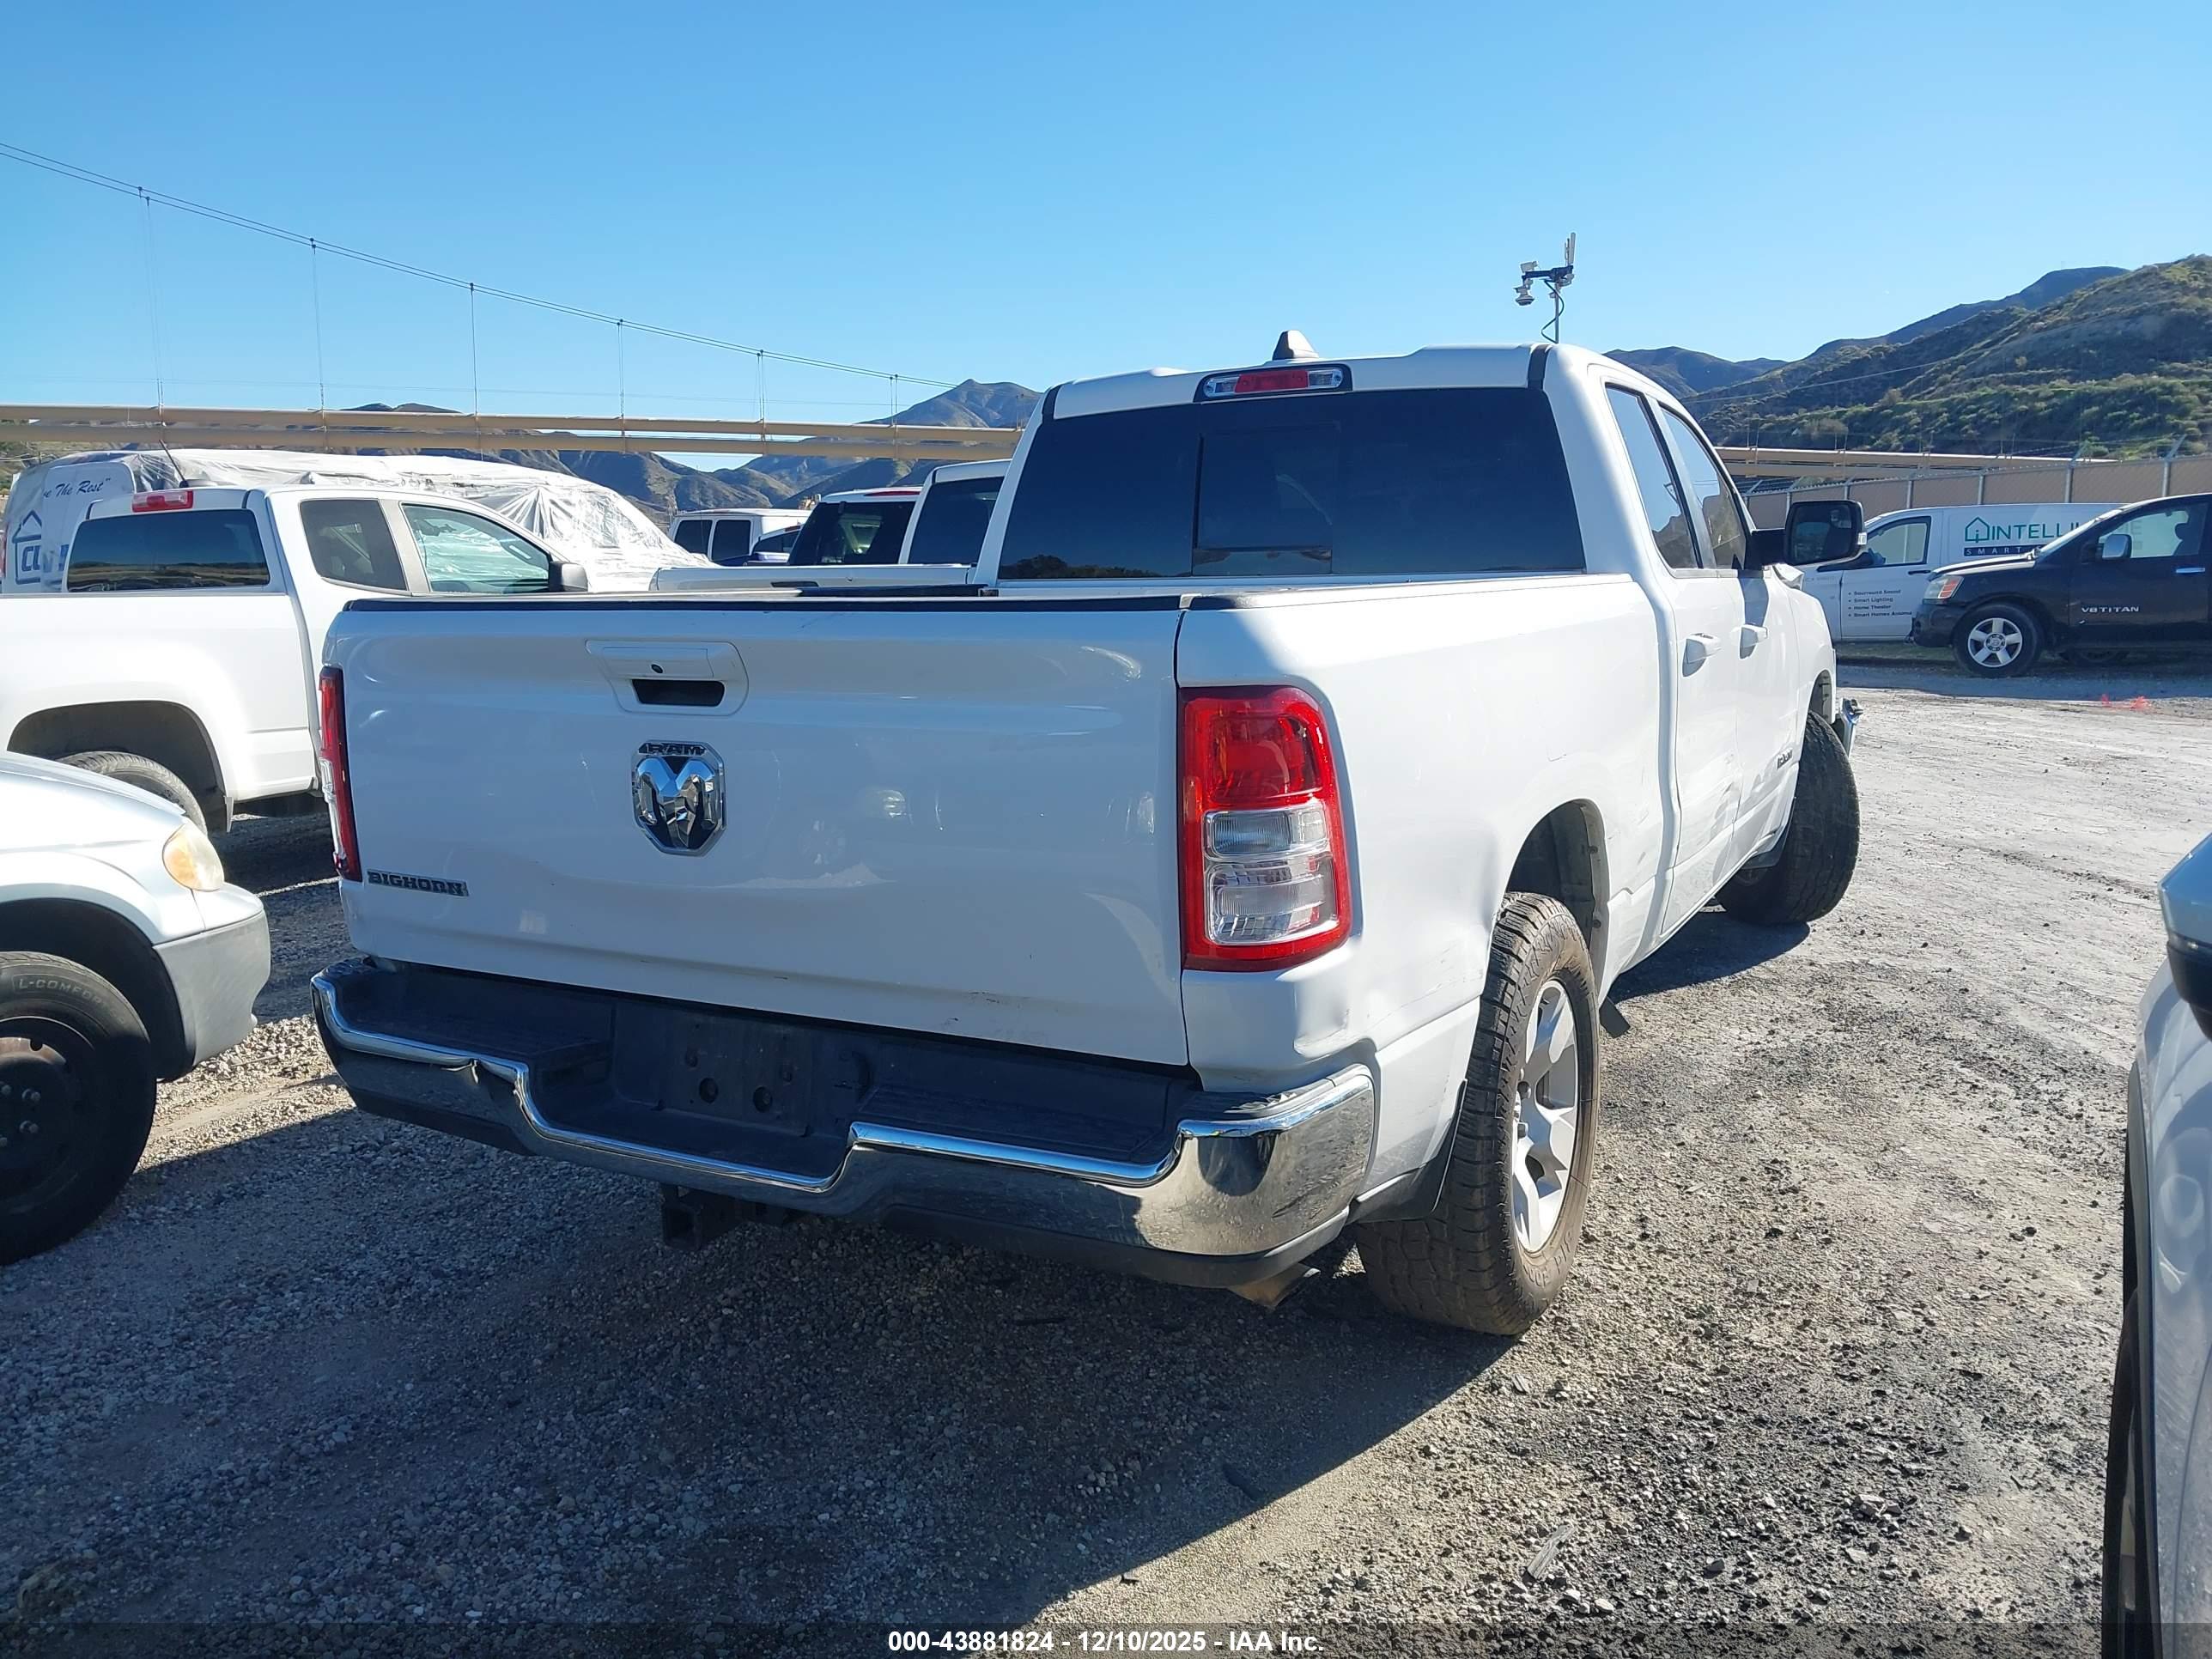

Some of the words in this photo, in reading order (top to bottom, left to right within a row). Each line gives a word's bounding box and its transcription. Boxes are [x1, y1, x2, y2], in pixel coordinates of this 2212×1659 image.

[55, 483, 74, 497] The
[1991, 522, 2080, 541] INTELLI
[1966, 546, 2022, 556] SMART
[646, 743, 700, 756] RAM
[367, 871, 469, 896] BIGHORN
[18, 978, 108, 1008] L-COMFOR
